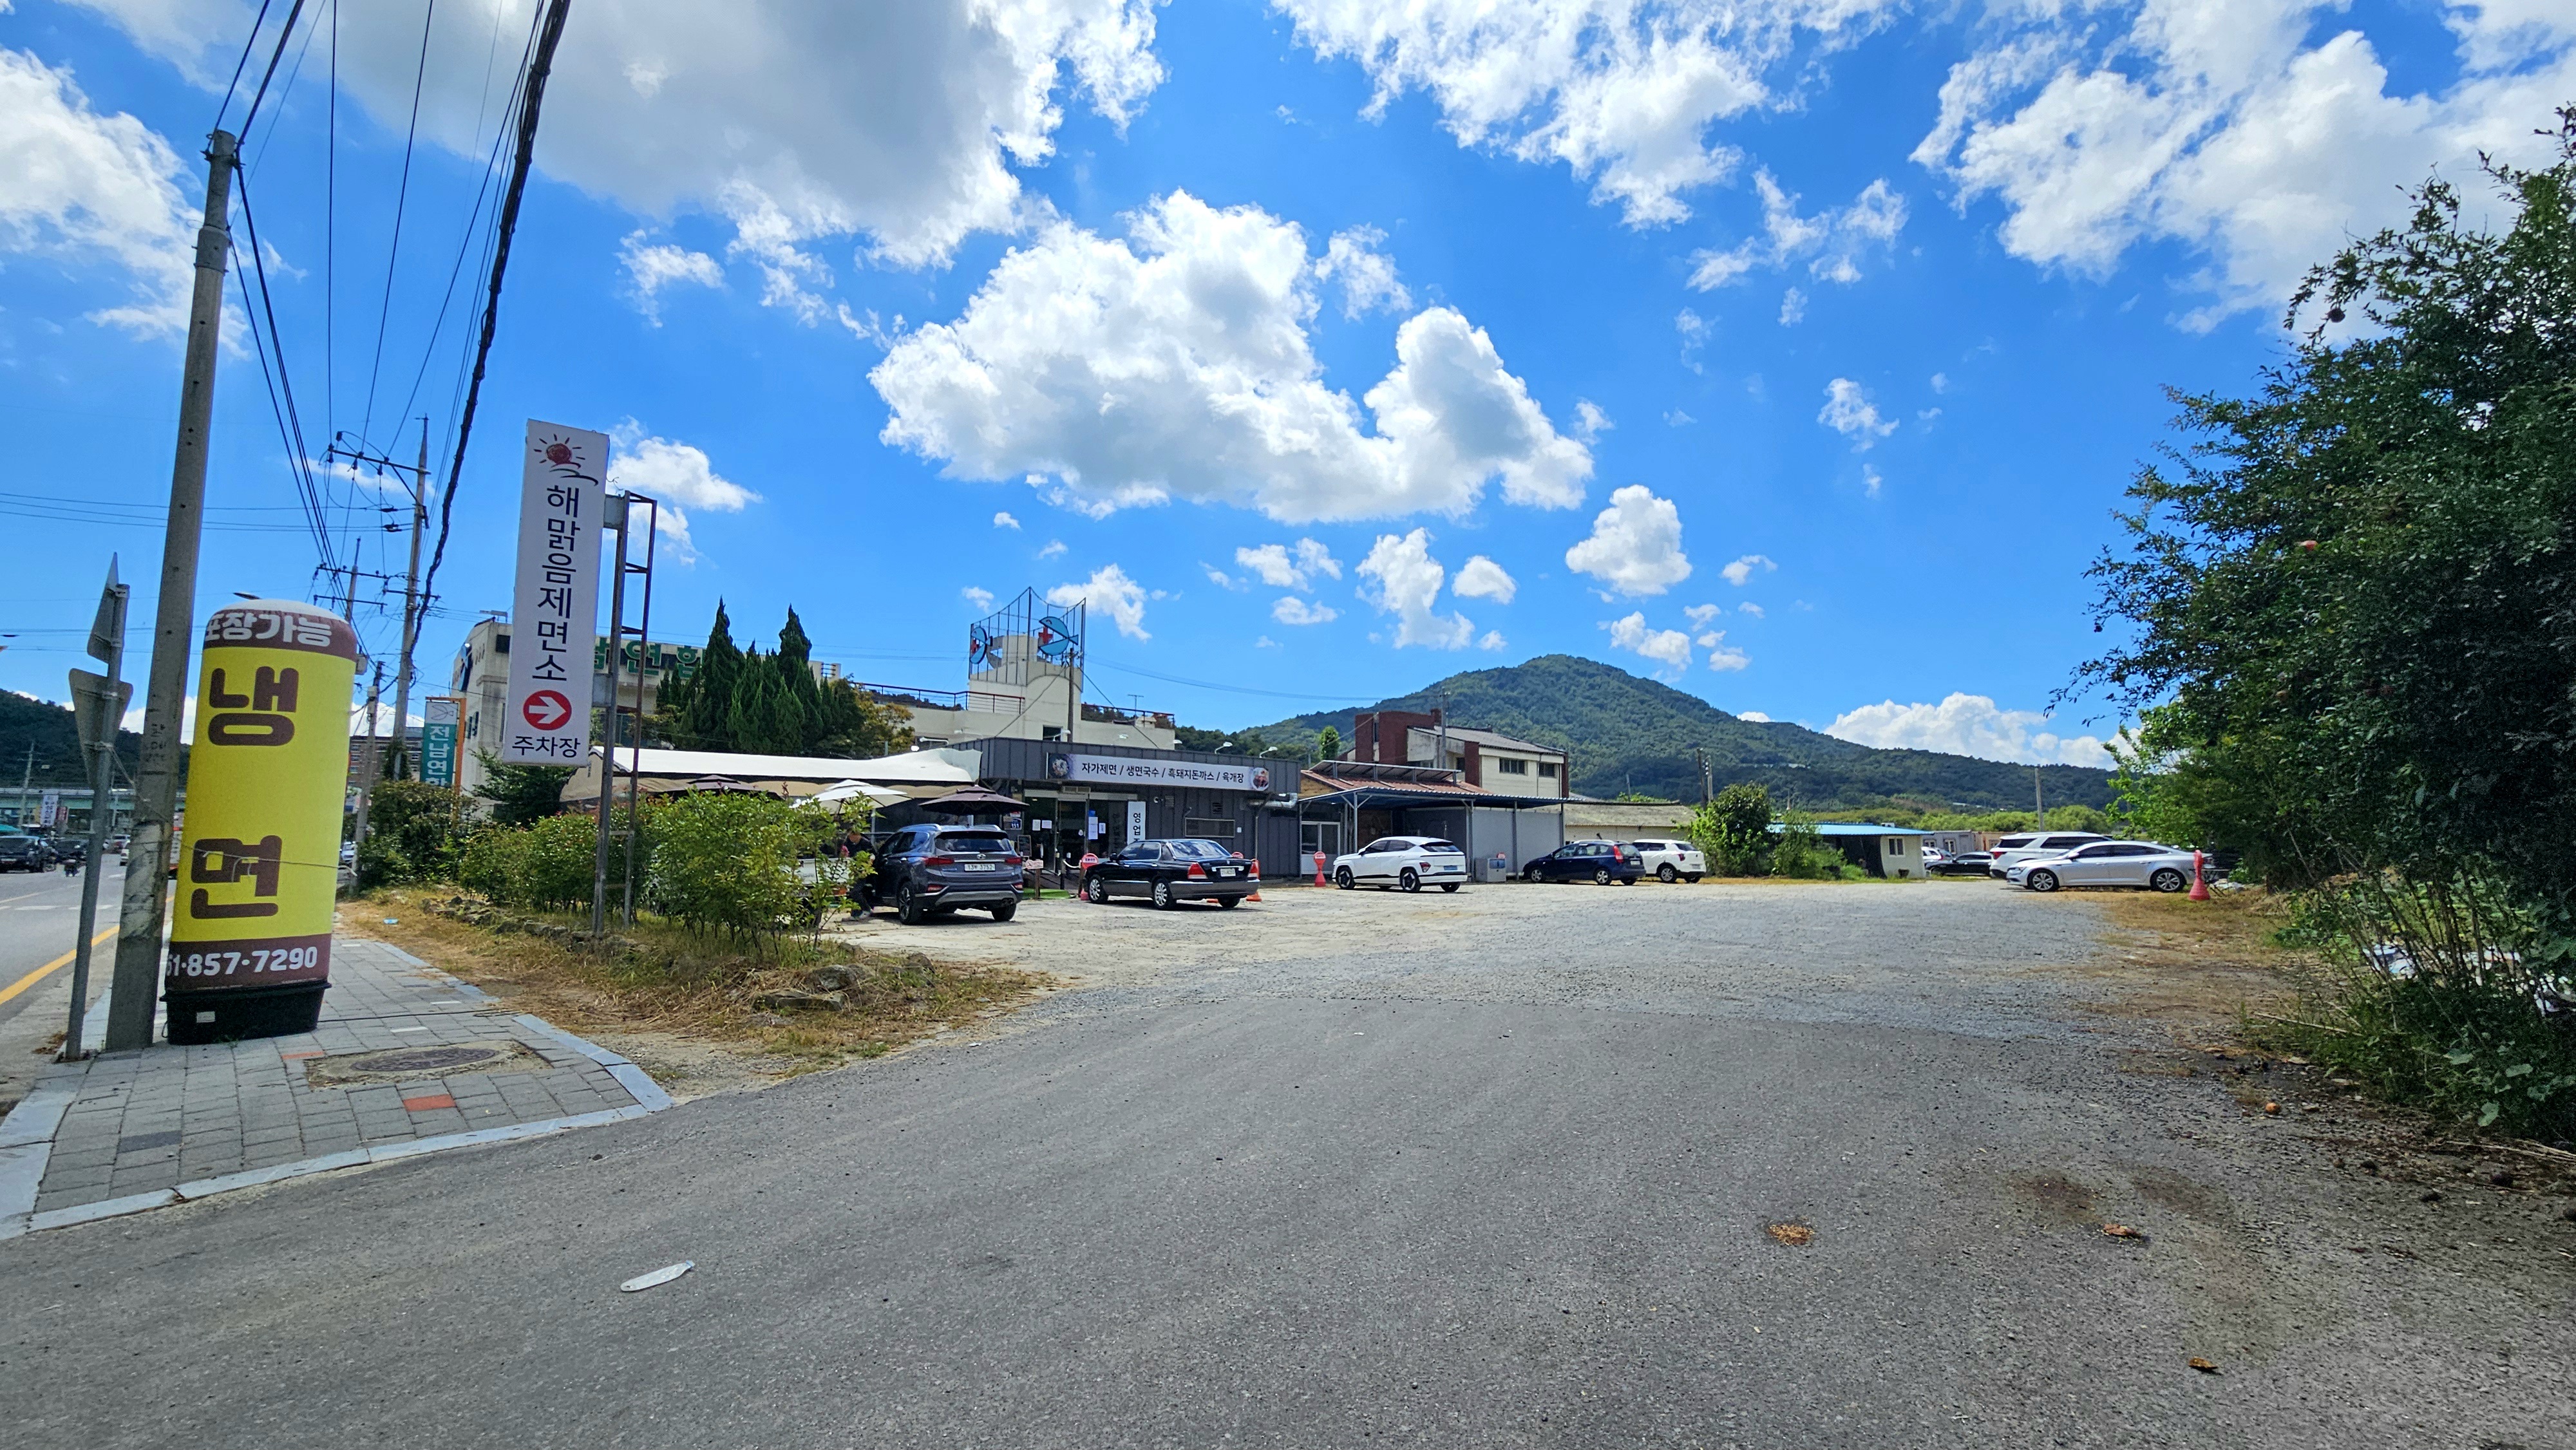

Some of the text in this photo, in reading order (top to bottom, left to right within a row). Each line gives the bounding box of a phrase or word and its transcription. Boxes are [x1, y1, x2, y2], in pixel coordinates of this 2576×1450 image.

[531, 485, 580, 682] 해맑음제면소
[205, 612, 332, 647] 포장가능
[512, 735, 581, 758] 주차장
[1082, 762, 1244, 784] 자가제면 / 생면국수 / 흑돼지돈까스 / 육개장
